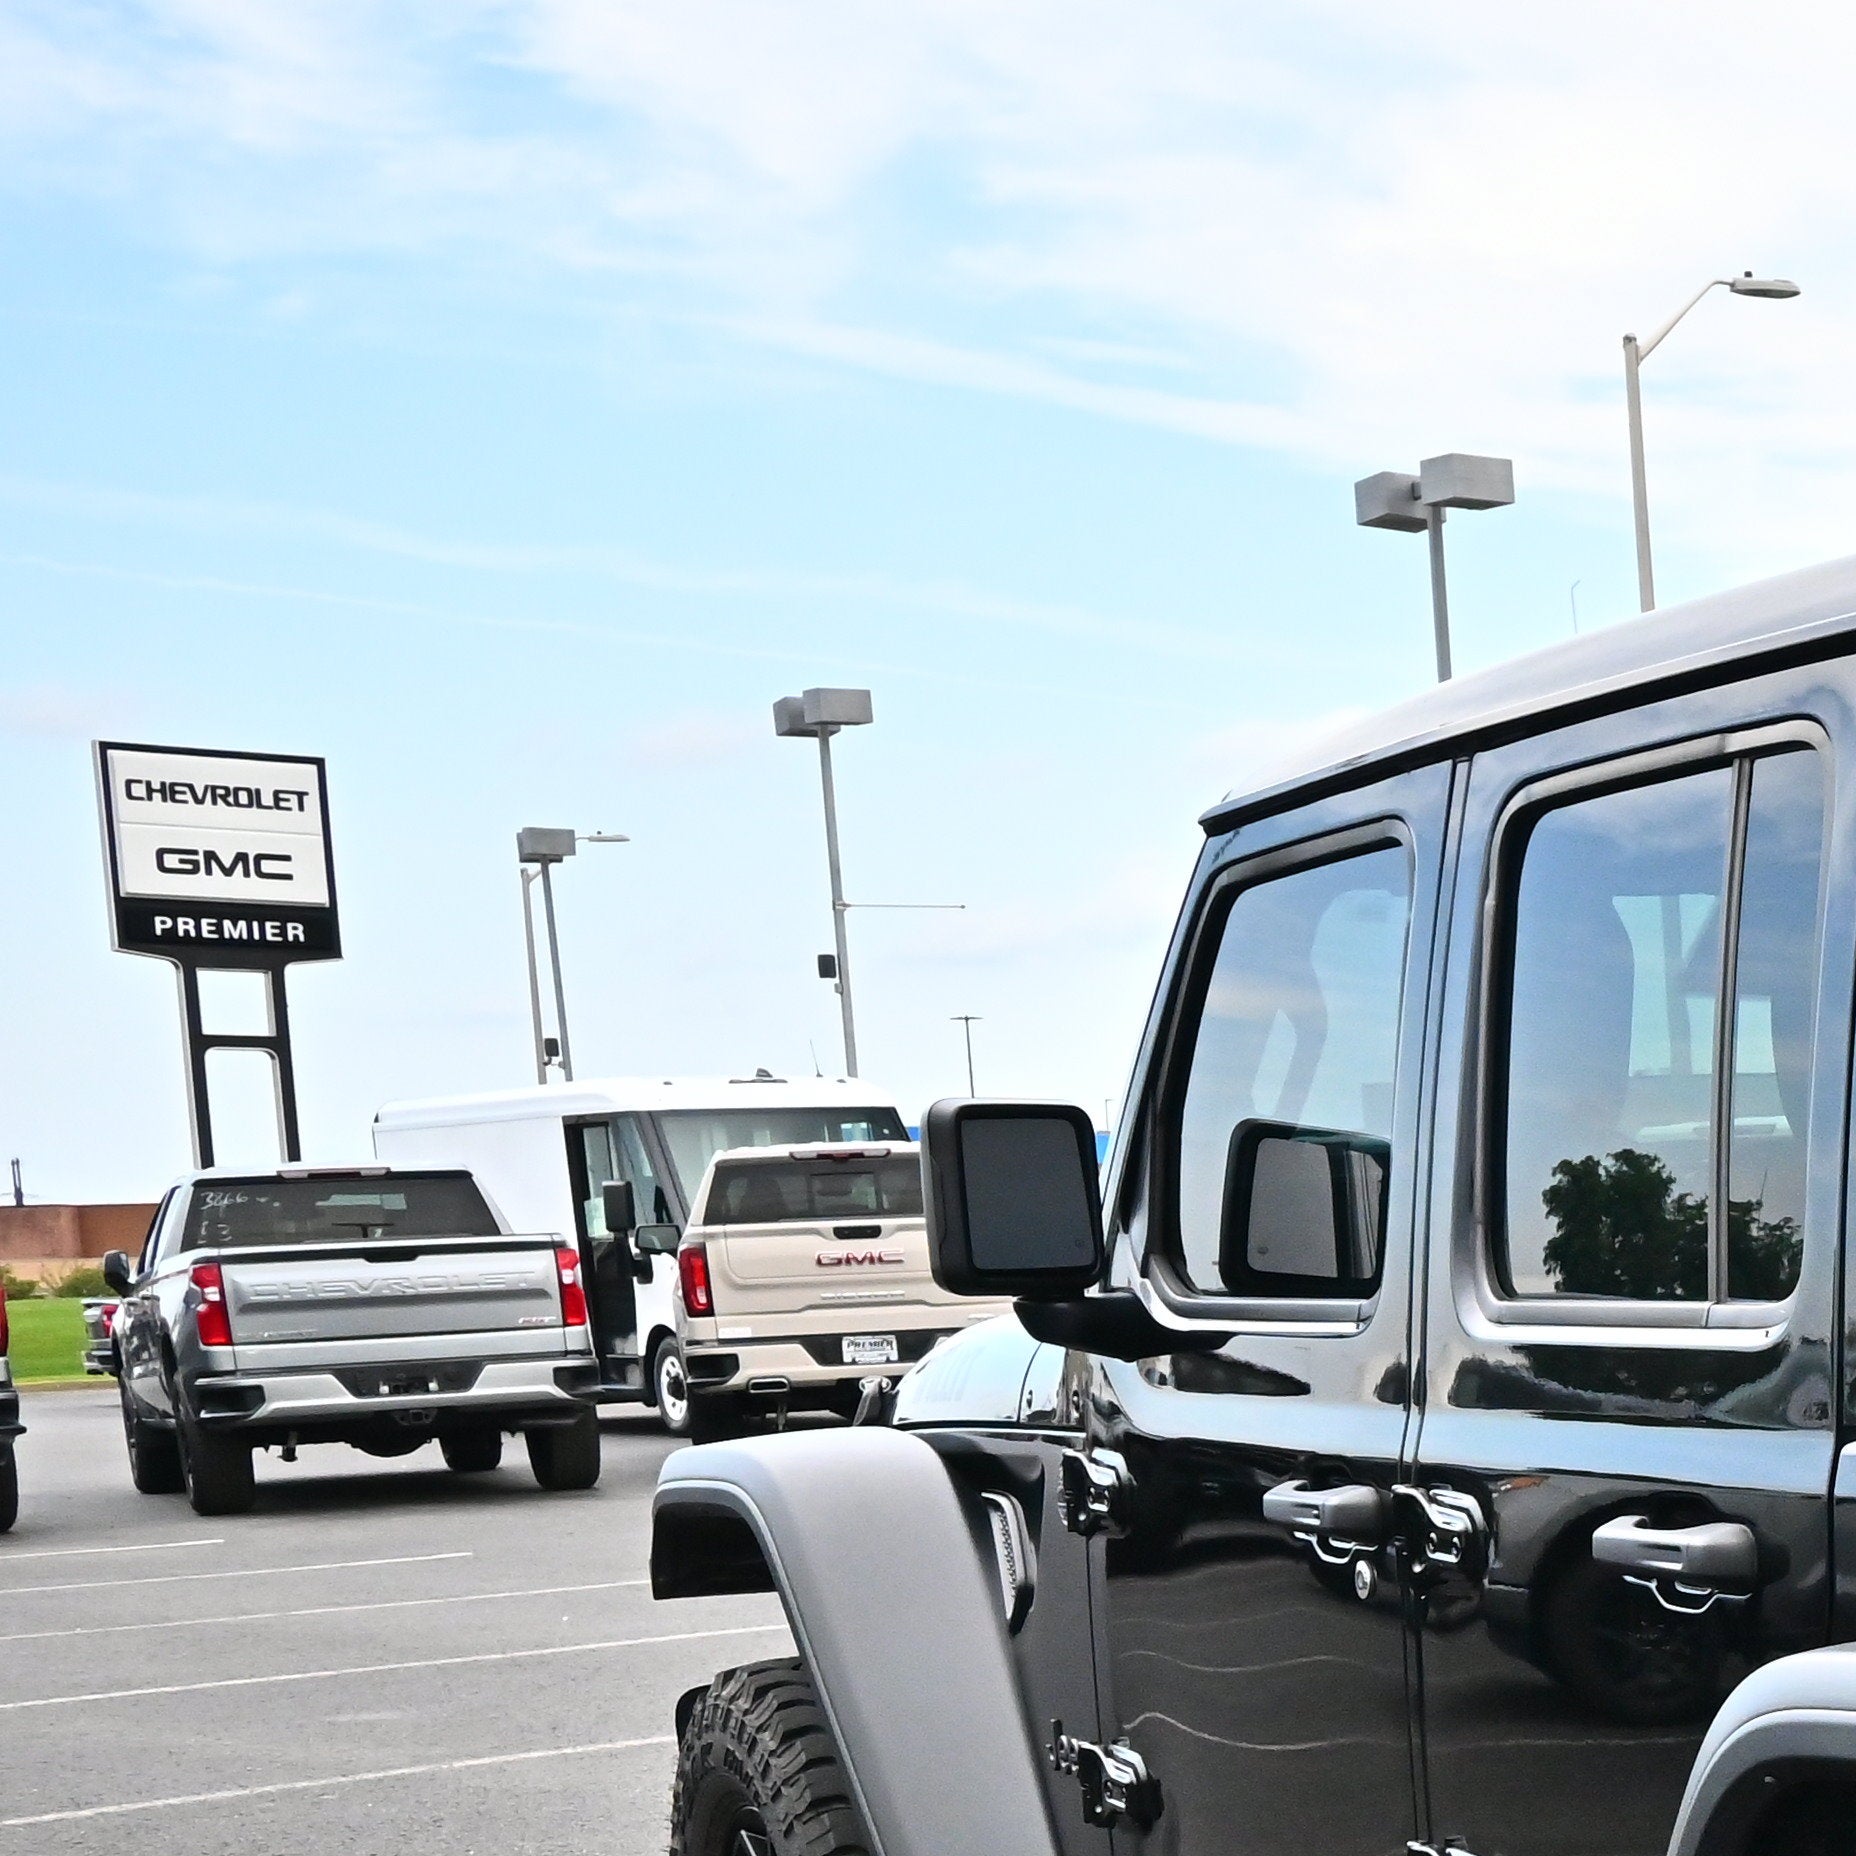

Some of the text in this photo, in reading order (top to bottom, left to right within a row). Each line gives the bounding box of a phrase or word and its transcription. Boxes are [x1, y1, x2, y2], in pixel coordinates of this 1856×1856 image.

[124, 778, 310, 812] CHEVROLET
[155, 847, 294, 881] GMC
[154, 916, 305, 942] PREMIER
[815, 1248, 906, 1267] GMC
[250, 1270, 536, 1300] CHEVROLET
